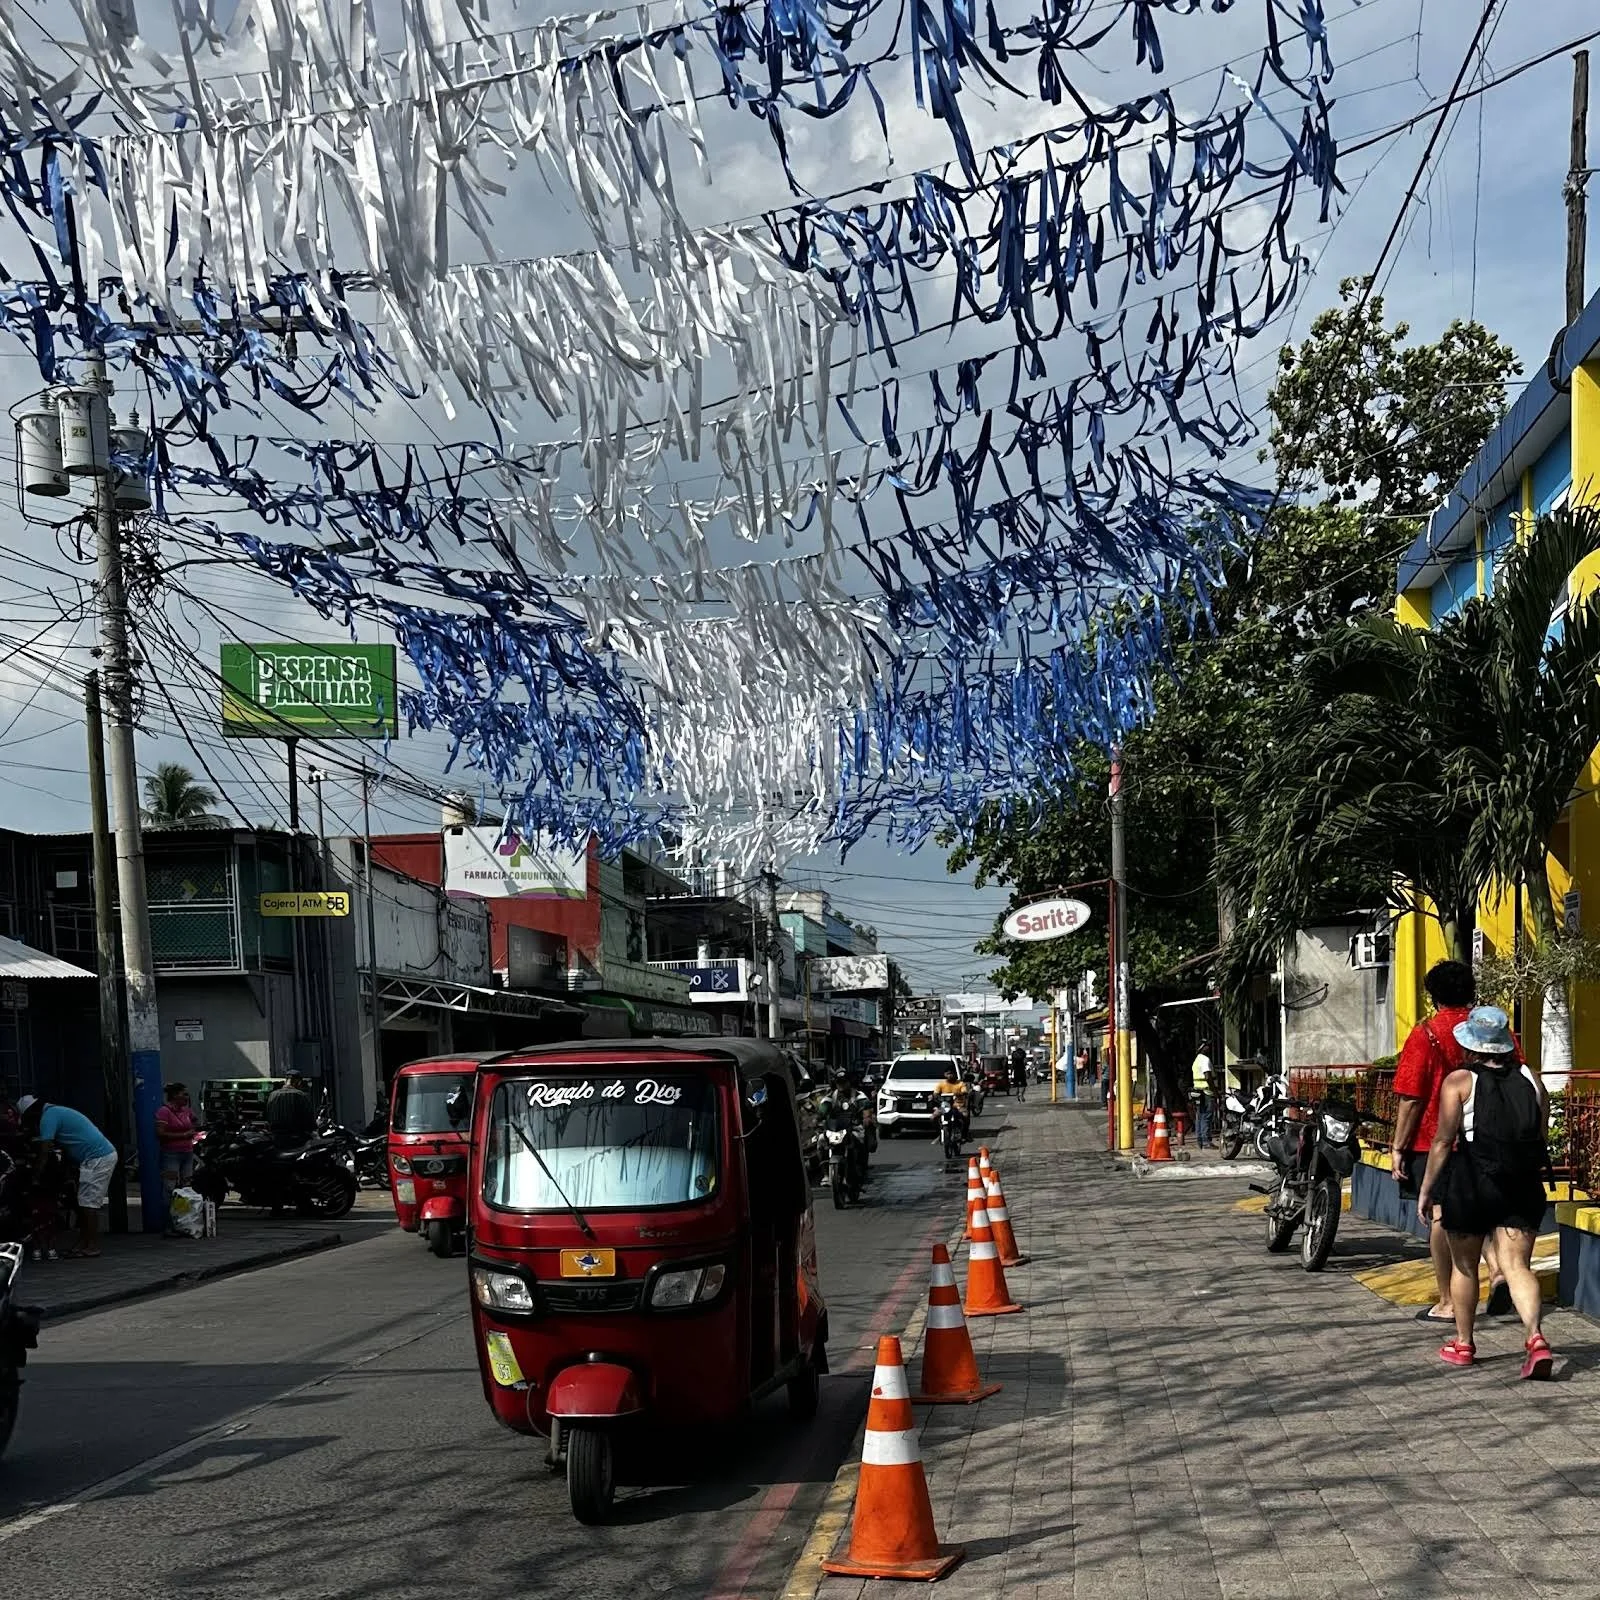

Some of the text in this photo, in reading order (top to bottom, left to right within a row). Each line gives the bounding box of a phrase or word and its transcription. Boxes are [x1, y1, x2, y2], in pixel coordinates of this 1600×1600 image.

[72, 427, 86, 437] 25
[256, 655, 371, 682] DESPENSA
[257, 681, 372, 706] FAMILIAR
[464, 870, 567, 881] FARMACIA COMUNITARIA
[263, 896, 345, 910] Cajero ATM 5B
[1016, 908, 1078, 935] Sarita
[527, 1079, 683, 1107] Regalo de Dios
[575, 1288, 609, 1301] TVS
